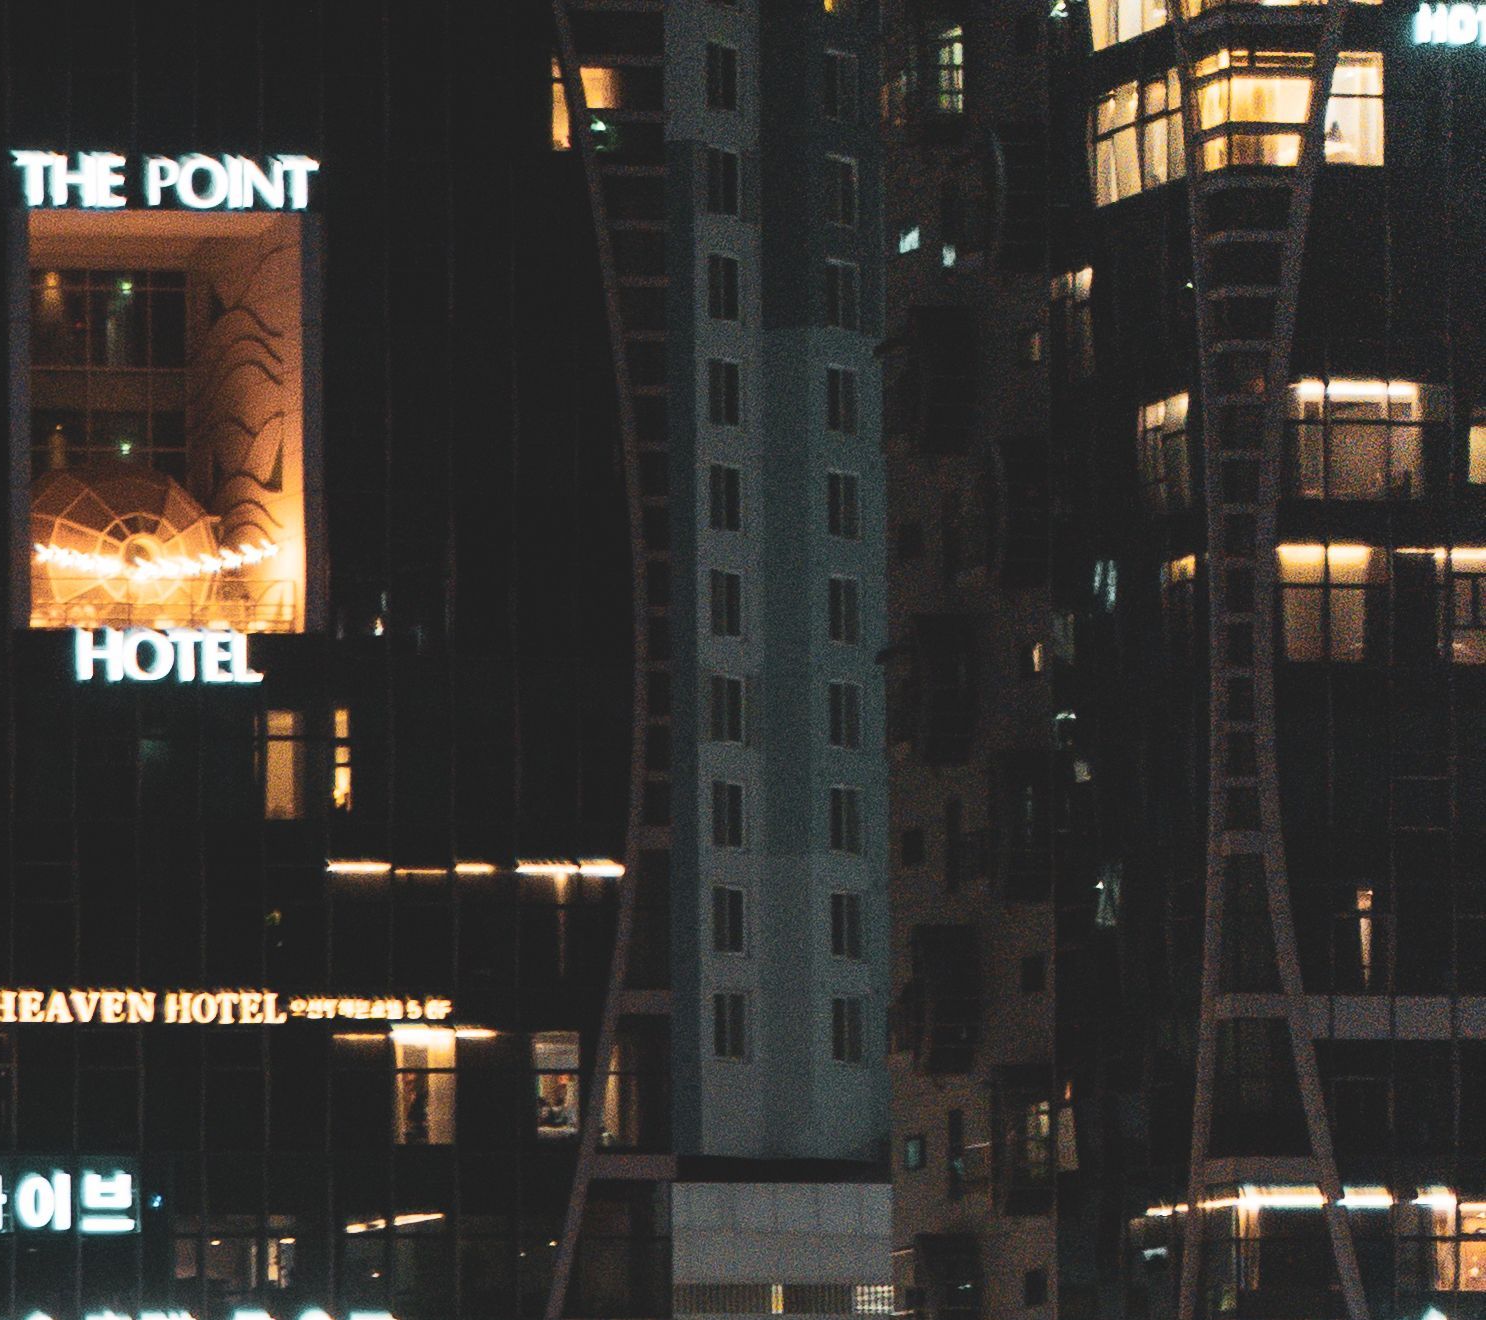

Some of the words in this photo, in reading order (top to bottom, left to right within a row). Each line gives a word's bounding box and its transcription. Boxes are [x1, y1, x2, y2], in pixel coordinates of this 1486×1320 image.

[16, 151, 129, 209] THE
[146, 154, 320, 209] POINT
[75, 630, 265, 682] HOTEL
[164, 990, 287, 1024] HOTEL
